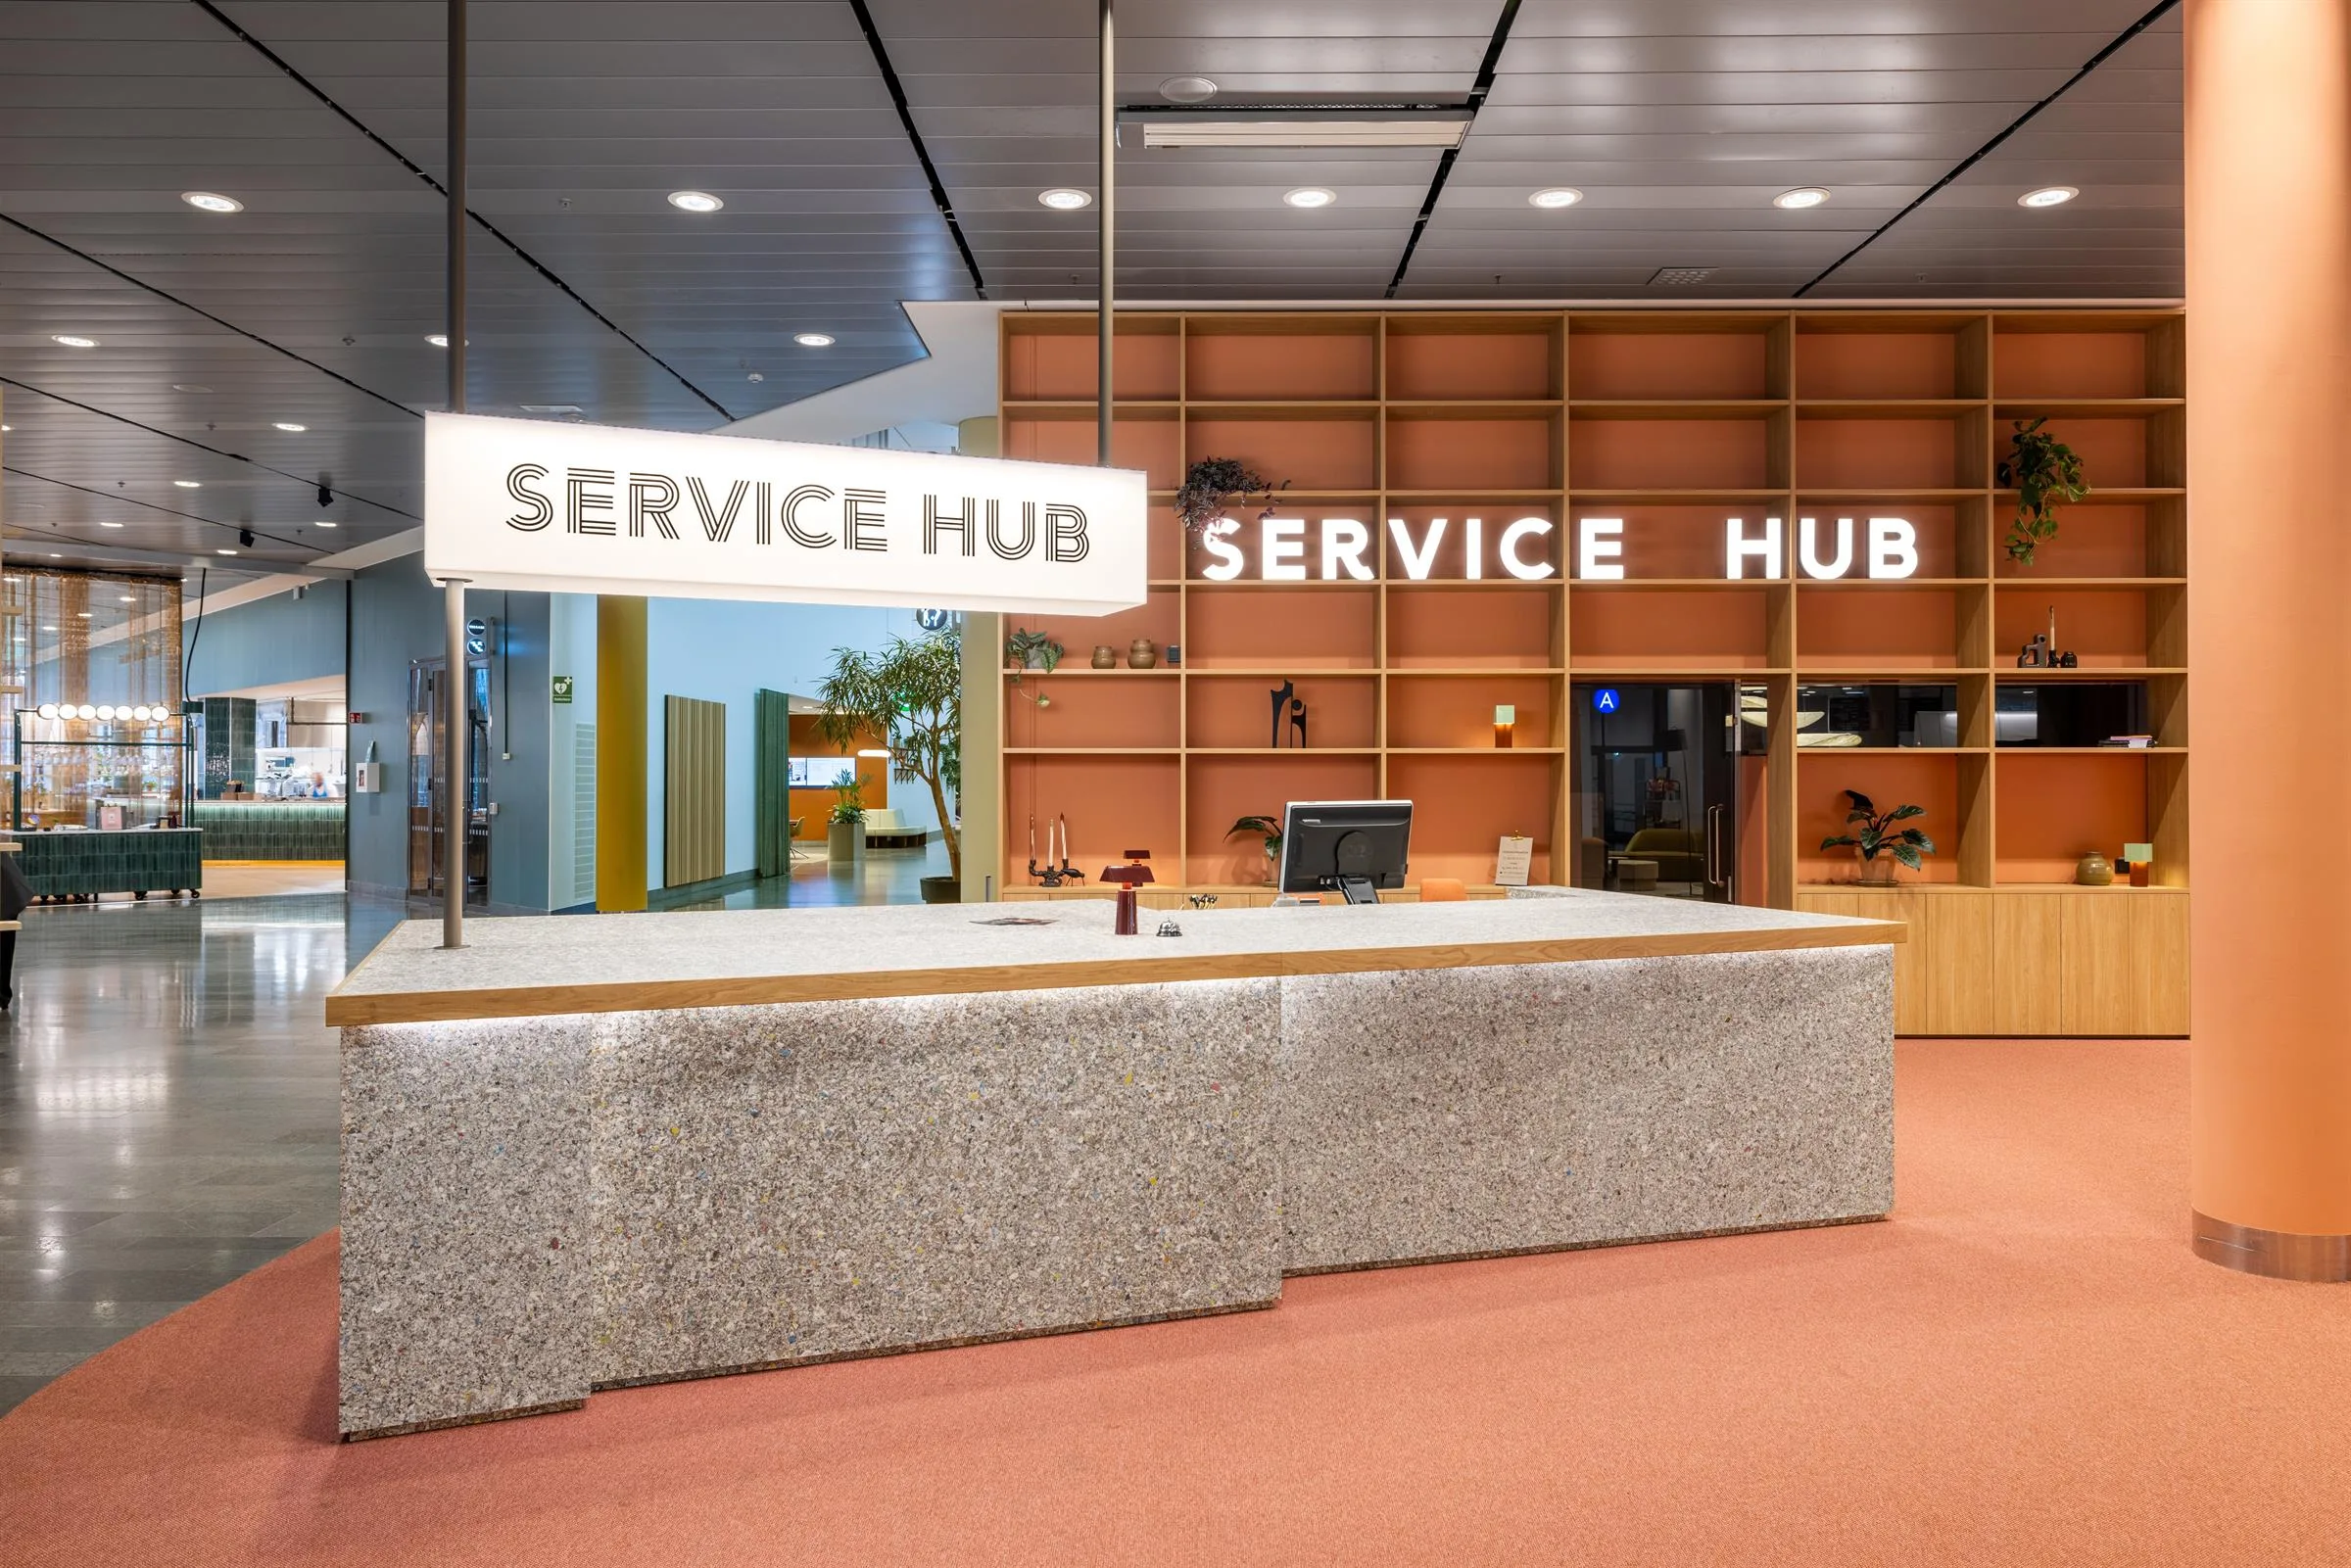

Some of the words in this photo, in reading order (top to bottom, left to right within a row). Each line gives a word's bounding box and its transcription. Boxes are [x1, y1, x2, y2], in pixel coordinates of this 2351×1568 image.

[505, 463, 888, 552] SERVICE
[923, 494, 1089, 562] HUB
[1202, 517, 1624, 581] SERVICE
[1726, 517, 1918, 580] HUB
[1599, 691, 1614, 709] A
